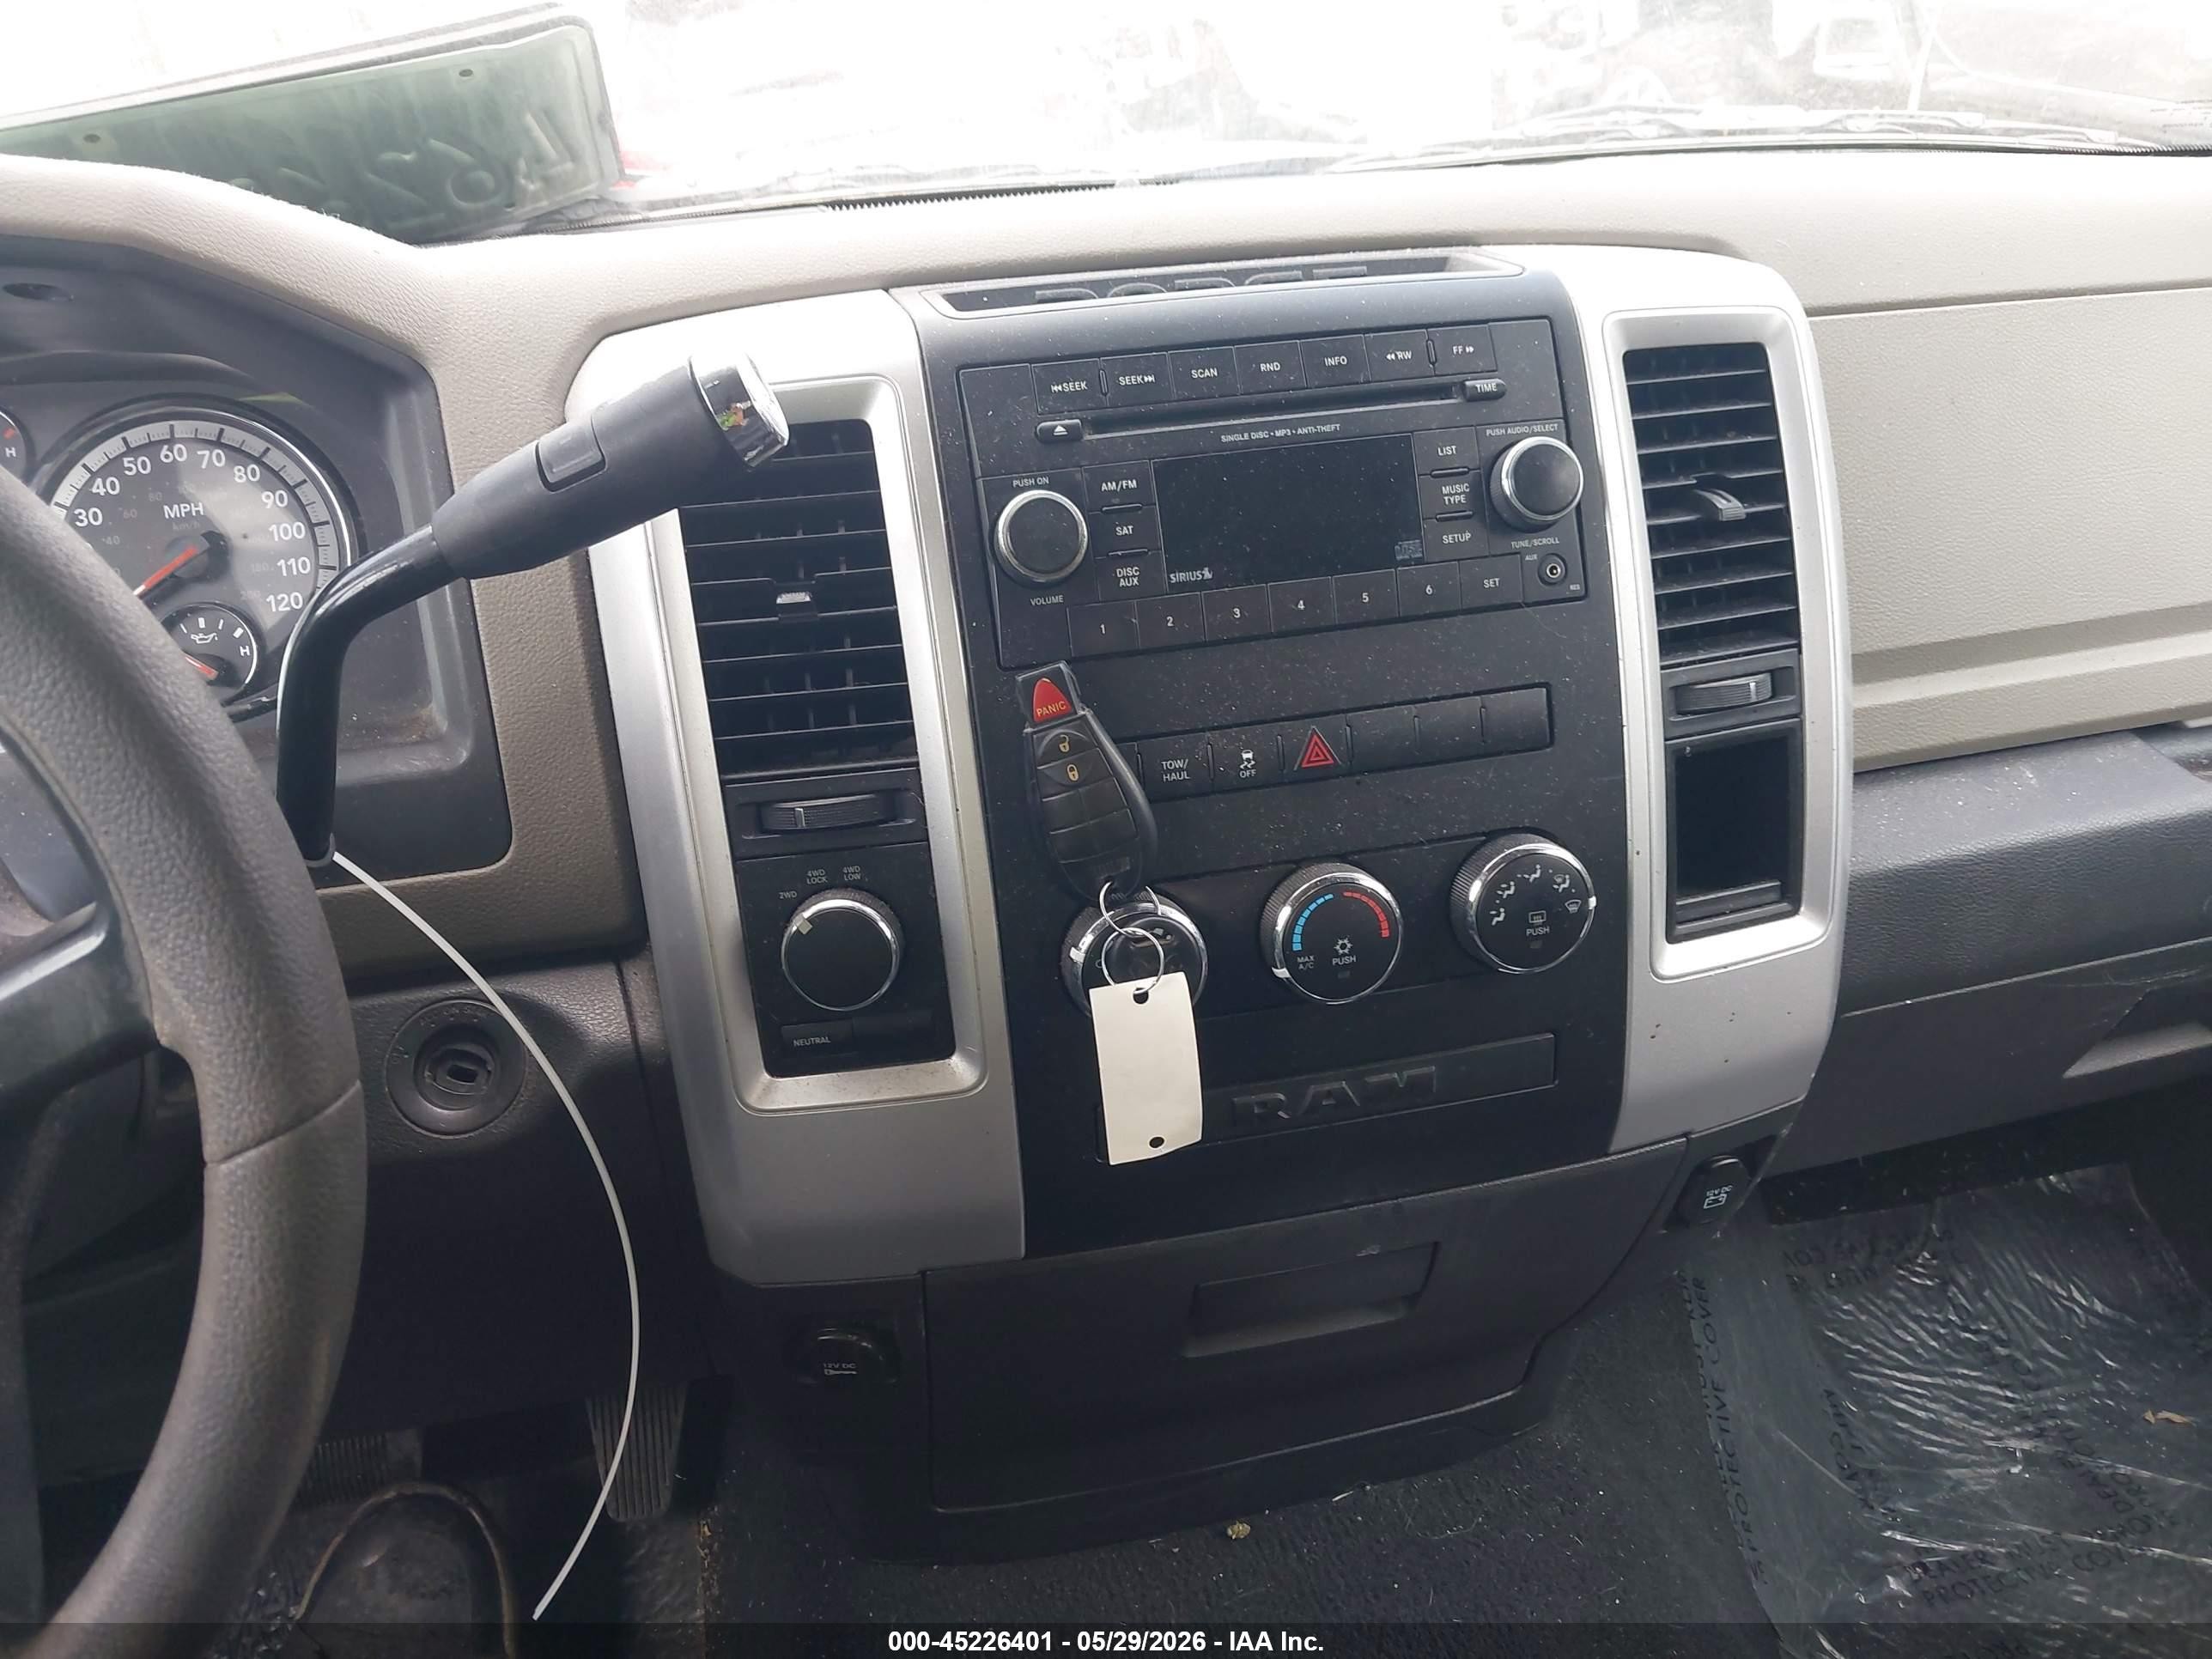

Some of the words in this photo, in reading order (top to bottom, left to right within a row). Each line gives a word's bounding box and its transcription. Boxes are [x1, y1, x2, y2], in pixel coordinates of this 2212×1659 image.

[1395, 350, 1413, 362] RW
[1452, 345, 1464, 356] FF
[1324, 355, 1348, 367] INFO
[1191, 367, 1218, 380] SCAN
[1260, 362, 1281, 374] RND
[1119, 374, 1143, 386] SEEK
[1063, 380, 1088, 393] SEEK
[1475, 382, 1498, 393] TIME
[1220, 432, 1249, 443] SINGLE
[1250, 430, 1269, 441] DISC
[1275, 428, 1291, 438] MP3
[1297, 423, 1340, 435] ANTI-THEFT
[1486, 428, 1506, 437] PUSH
[1507, 423, 1559, 434] AUDIO/SELECT
[5, 446, 16, 459] H
[159, 442, 189, 465] 60
[1437, 445, 1457, 456] LIST
[197, 447, 227, 470] 70
[122, 455, 152, 477] 50
[233, 463, 261, 483] 80
[90, 476, 121, 497] 40
[1012, 477, 1034, 489] PUSH
[1036, 476, 1049, 486] ON
[1101, 478, 1138, 493] AM/FM
[1442, 483, 1470, 495] MUSIC
[261, 489, 289, 510] 90
[1443, 494, 1467, 505] TYPE
[163, 501, 205, 520] MPH
[74, 507, 104, 528] 30
[268, 520, 307, 542] 100
[1115, 525, 1134, 536] SAT
[1442, 532, 1472, 544] SETUP
[1510, 537, 1560, 550] TUNE/SCROLL
[276, 555, 312, 578] 110
[1116, 566, 1140, 578] DISC
[1119, 576, 1140, 587] AUX
[1170, 569, 1203, 584] SIRIUS
[1483, 578, 1500, 589] SET
[1425, 585, 1434, 595] 6
[265, 591, 304, 614] 120
[1030, 594, 1064, 606] VOLUME
[1362, 592, 1370, 604] 5
[1297, 599, 1305, 611] 4
[1232, 608, 1242, 619] 3
[1166, 616, 1175, 628] 2
[1100, 623, 1106, 635] 1
[240, 645, 251, 657] H
[1036, 699, 1067, 718] PANIC
[1160, 757, 1189, 770] TOW/
[1163, 769, 1191, 782] HAUL
[1239, 769, 1257, 779] OFF
[806, 868, 826, 878] 4WD
[842, 866, 861, 874] 4WD
[806, 876, 828, 885] LOCK
[844, 872, 861, 882] LOW
[1525, 925, 1550, 938] PUSH
[1297, 954, 1316, 964] MAX
[1332, 954, 1357, 967] PUSH
[1297, 961, 1315, 971] A/C
[793, 1036, 831, 1048] NEUTRAL
[1231, 1065, 1437, 1124] RAM
